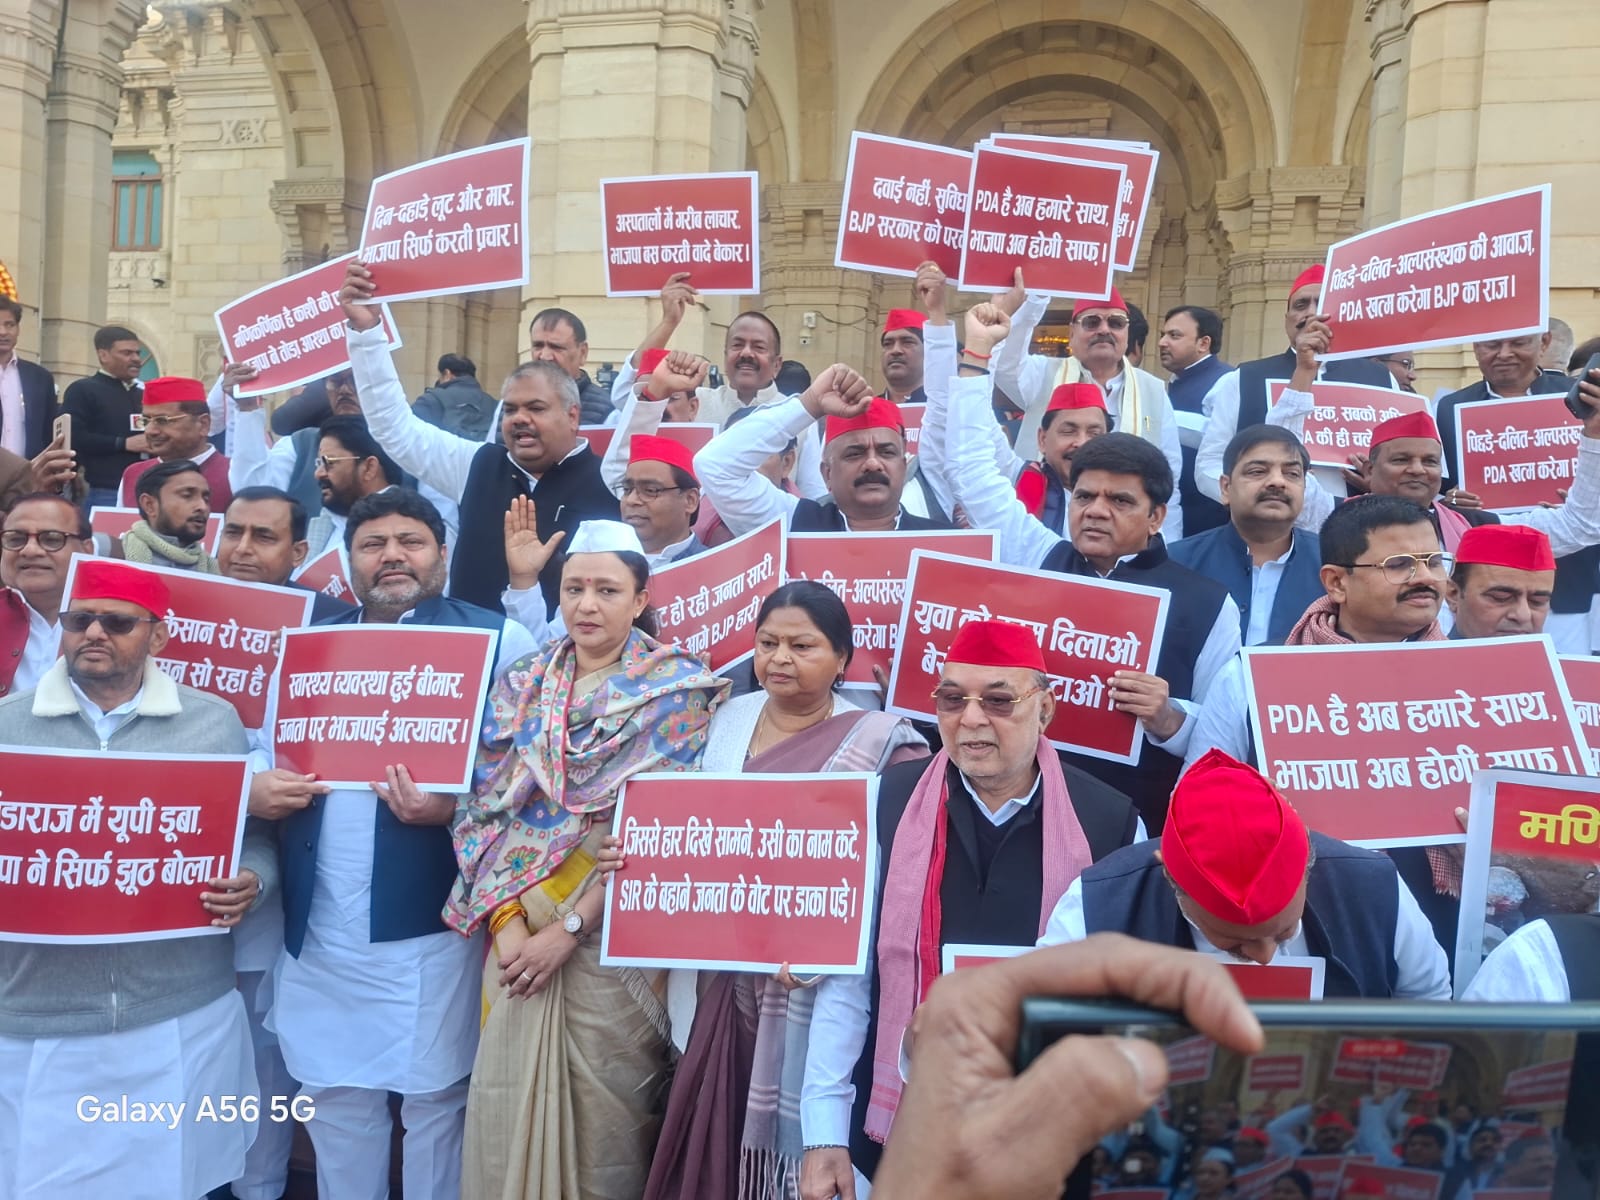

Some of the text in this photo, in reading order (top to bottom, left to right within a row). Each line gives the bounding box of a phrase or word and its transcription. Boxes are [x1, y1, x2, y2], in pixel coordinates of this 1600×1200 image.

[431, 193, 455, 226] लूट
[456, 184, 485, 212] और
[873, 175, 905, 204] दवाई
[935, 183, 967, 214] सुविध
[975, 189, 999, 214] PDA
[1001, 185, 1013, 217] है
[1013, 194, 1036, 217] अब
[1036, 194, 1074, 223] हमारे
[616, 206, 661, 233] अस्पतालों
[663, 206, 674, 231] में
[675, 205, 703, 231] गरीब
[849, 211, 875, 233] BJP
[877, 215, 923, 242] सरकार
[923, 218, 942, 244] को
[403, 229, 434, 260] सिर्फ
[436, 222, 474, 255] करती
[610, 246, 641, 265] भाजपा
[643, 245, 659, 265] बस
[661, 238, 691, 264] करती
[692, 239, 711, 264] वादे
[970, 229, 1006, 254] भाजपा
[1006, 234, 1028, 255] अब
[1028, 230, 1063, 259] होगी
[1469, 232, 1489, 262] की
[284, 306, 295, 328] है
[292, 296, 320, 324] काशी
[318, 290, 334, 313] की
[1339, 302, 1363, 323] PDA
[1366, 292, 1395, 321] खत्म
[1397, 284, 1431, 314] करेगा
[1434, 283, 1460, 309] BJP
[1462, 280, 1481, 304] का
[268, 345, 281, 366] ने
[299, 329, 332, 353] आस्था
[328, 321, 345, 341] का
[1341, 404, 1376, 423] सबको
[1315, 427, 1333, 446] की
[1335, 427, 1350, 448] ही
[1484, 465, 1507, 485] PDA
[1509, 462, 1536, 484] खत्म
[1538, 455, 1569, 480] करेगा
[669, 595, 685, 626] हो
[686, 585, 710, 618] रही
[711, 571, 746, 607] जनता
[218, 618, 240, 650] रो
[241, 627, 273, 655] रहा
[711, 614, 734, 646] BJP
[852, 617, 887, 650] करेगा
[914, 600, 957, 635] युवा
[1049, 617, 1142, 670] दिलाओ,
[190, 657, 214, 688] सो
[215, 668, 249, 694] रहा
[248, 665, 266, 697] है
[289, 664, 465, 703] स्वास्थ्य व्यवस्था हुई बीमार,
[277, 717, 309, 744] जनता
[308, 717, 329, 743] पर
[328, 710, 389, 746] भाजपाई
[1267, 704, 1325, 734] PDA
[1326, 693, 1350, 737] है
[1355, 700, 1400, 733] अब
[1403, 688, 1480, 733] हमारे
[1481, 691, 1558, 728] साथ,
[1274, 759, 1360, 791] भाजपा
[1366, 757, 1412, 790] अब
[1417, 744, 1480, 790] होगी
[0, 791, 202, 843] डाराज में यूपी डूबा,
[1519, 804, 1600, 846] मणि
[623, 816, 861, 862] जिससे हार दिखे सामने, उसी का नाम कटे,
[26, 849, 50, 887] ने
[53, 847, 113, 890] सिर्फ
[115, 858, 159, 896] झूठ
[619, 879, 643, 912] SIR
[643, 873, 659, 911] के
[658, 873, 693, 915] बहाने
[692, 880, 730, 914] जनता
[730, 873, 747, 913] के
[746, 875, 772, 916] वोट
[773, 884, 795, 918] पर
[794, 885, 829, 918] डाका
